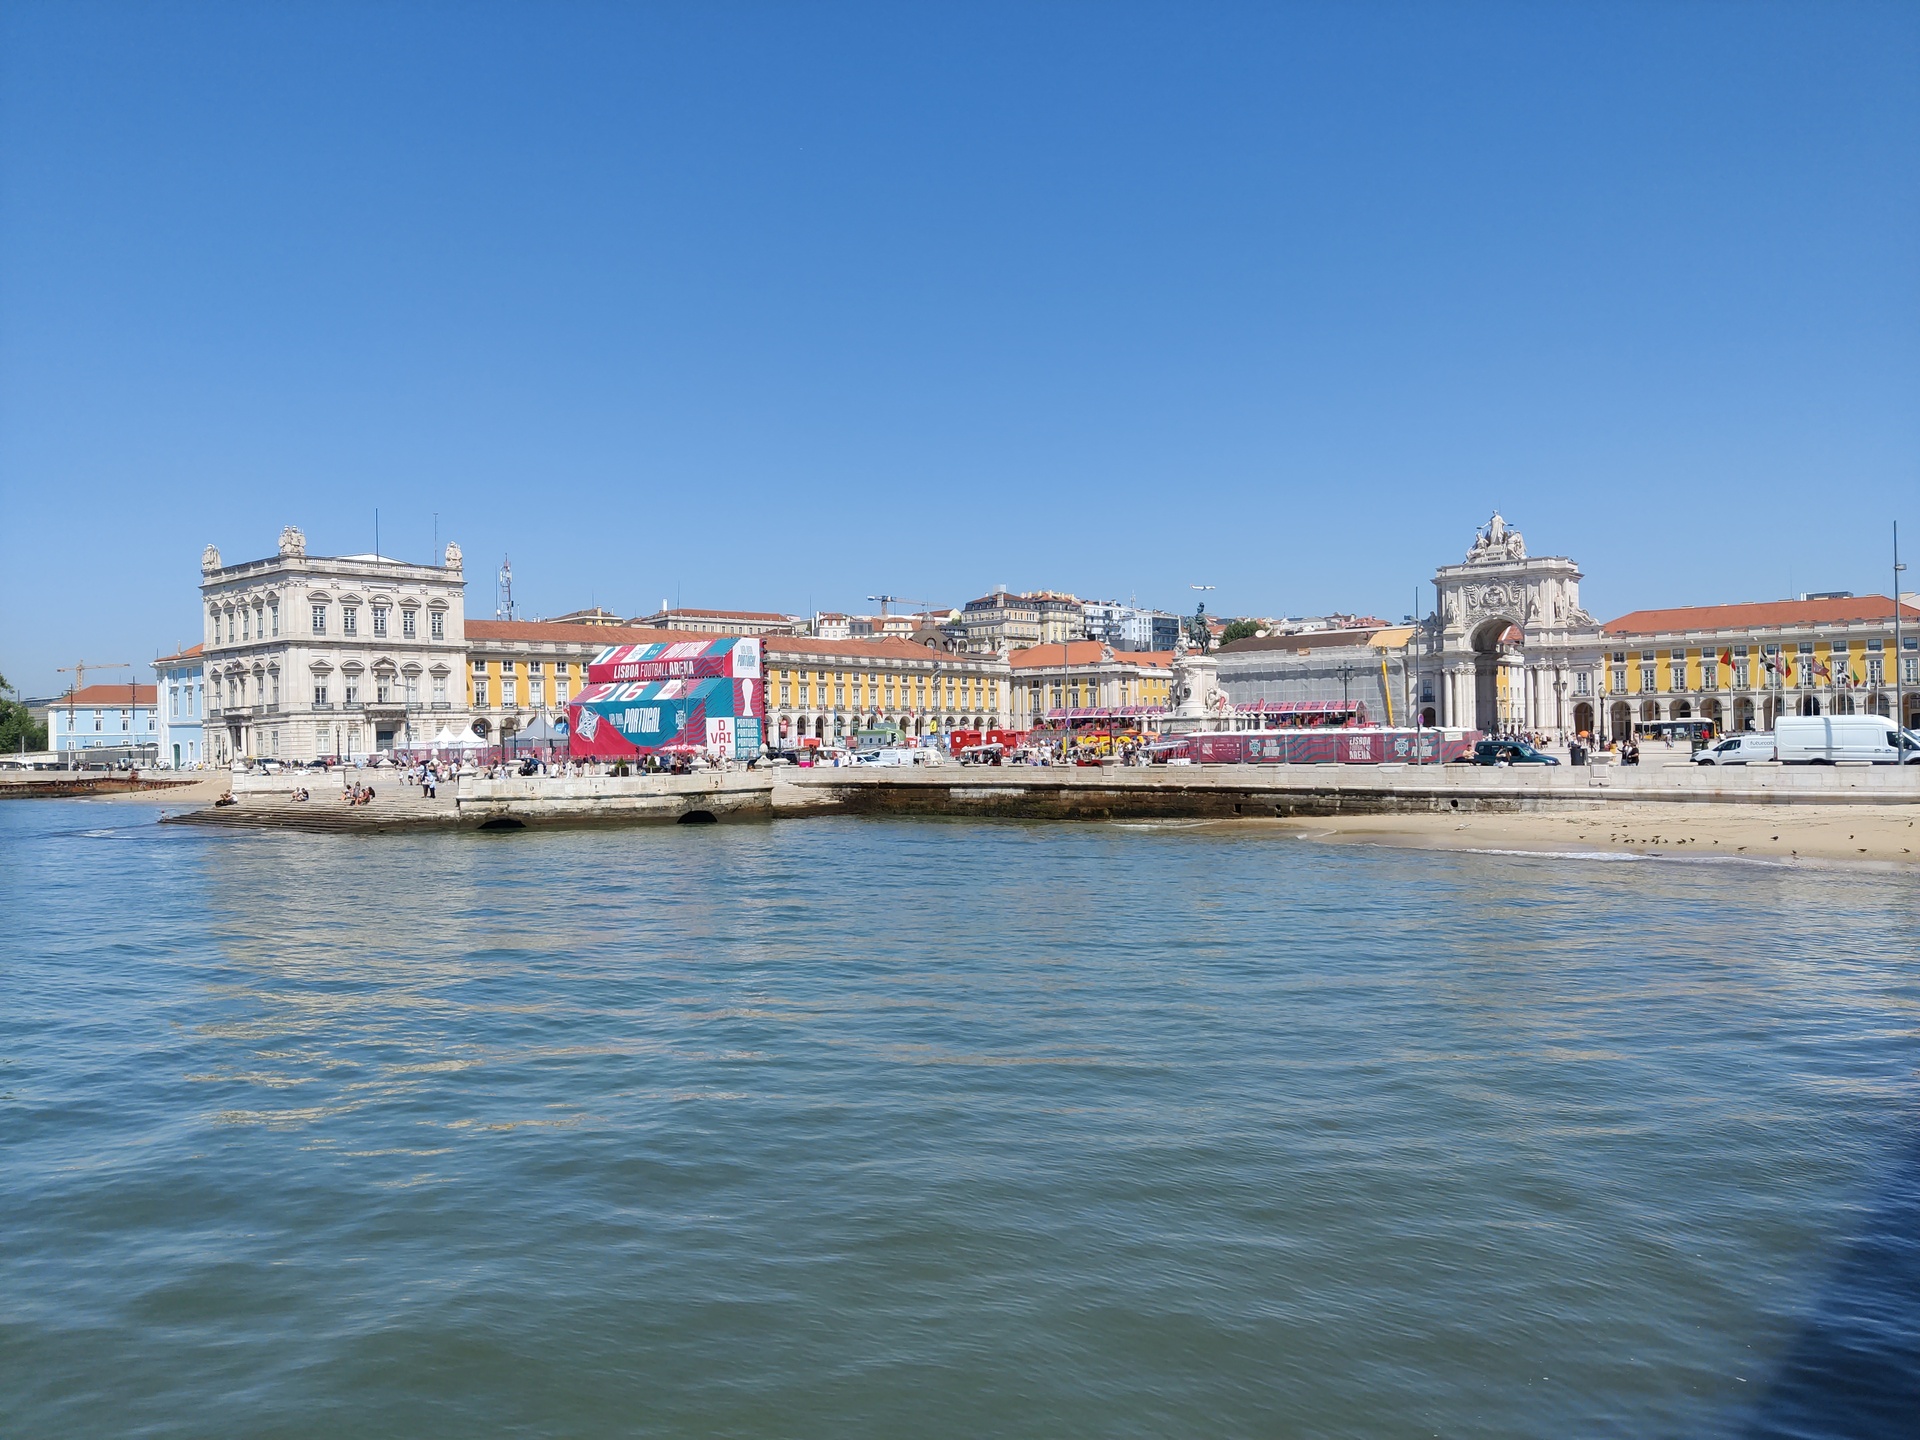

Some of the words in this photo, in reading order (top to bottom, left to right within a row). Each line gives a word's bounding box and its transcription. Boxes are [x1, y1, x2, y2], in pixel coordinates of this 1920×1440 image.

[613, 663, 639, 679] LISBOA
[639, 661, 669, 678] FOOTBALL
[668, 660, 695, 676] ARENA
[622, 707, 661, 734] PORTUGAL
[1349, 750, 1371, 760] ARENA
